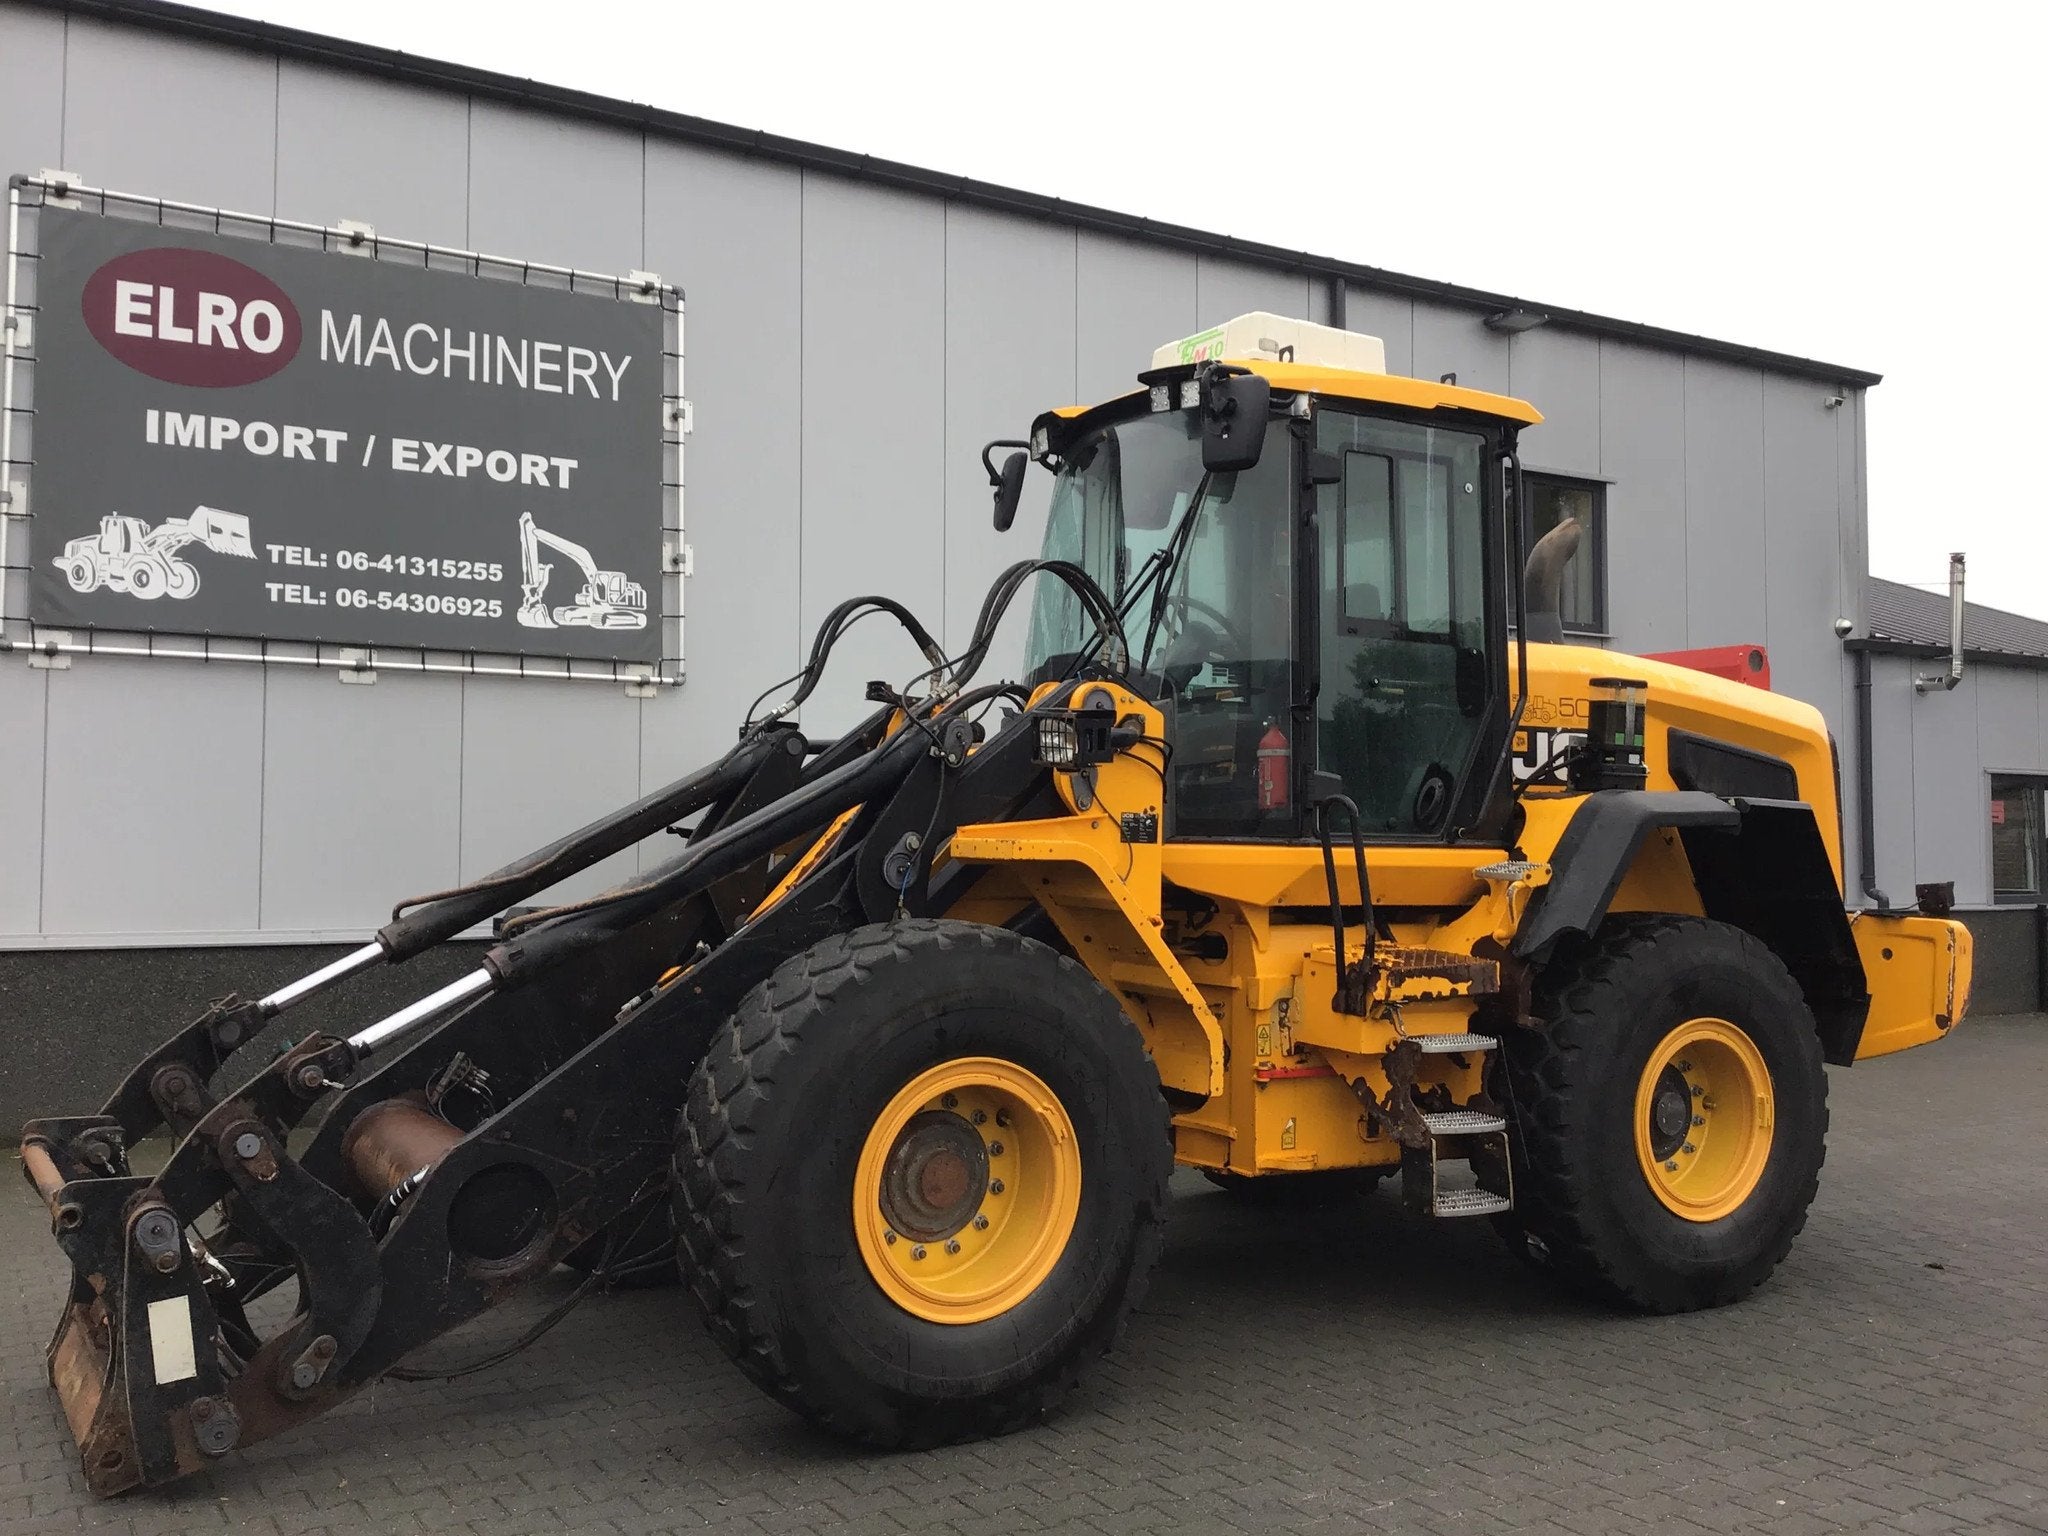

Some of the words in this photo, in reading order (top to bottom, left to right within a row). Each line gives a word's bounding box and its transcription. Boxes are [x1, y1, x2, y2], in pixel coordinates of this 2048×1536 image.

[114, 279, 284, 354] ELRO
[320, 308, 633, 402] MACHINERY
[145, 408, 348, 464] IMPORT
[361, 434, 376, 468] /
[391, 437, 579, 490] EXPORT
[265, 543, 328, 568] TEL:
[336, 549, 504, 582] 06-41315255
[264, 582, 328, 606] TEL:
[335, 587, 503, 619] 06-54306925
